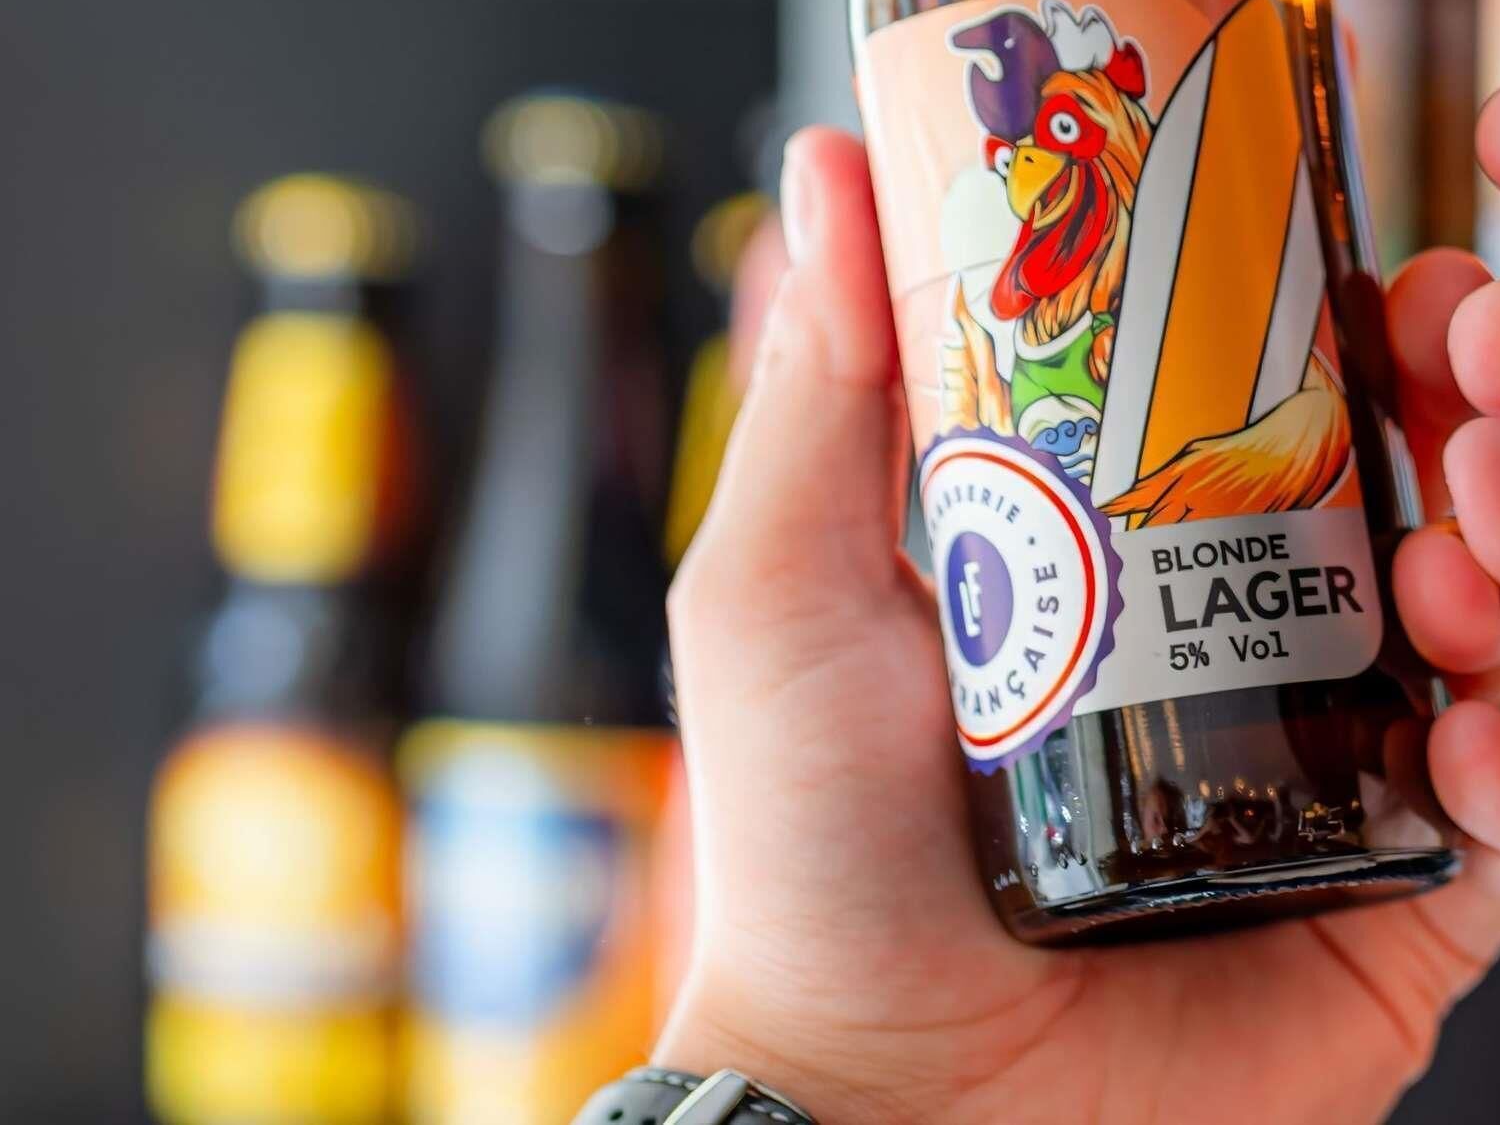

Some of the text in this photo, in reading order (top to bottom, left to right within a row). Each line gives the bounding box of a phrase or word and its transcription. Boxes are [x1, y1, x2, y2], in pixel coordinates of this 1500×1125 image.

[1151, 533, 1290, 575] BLONDE
[1159, 566, 1364, 633] LAGER
[1169, 630, 1290, 672] 5% Vol
